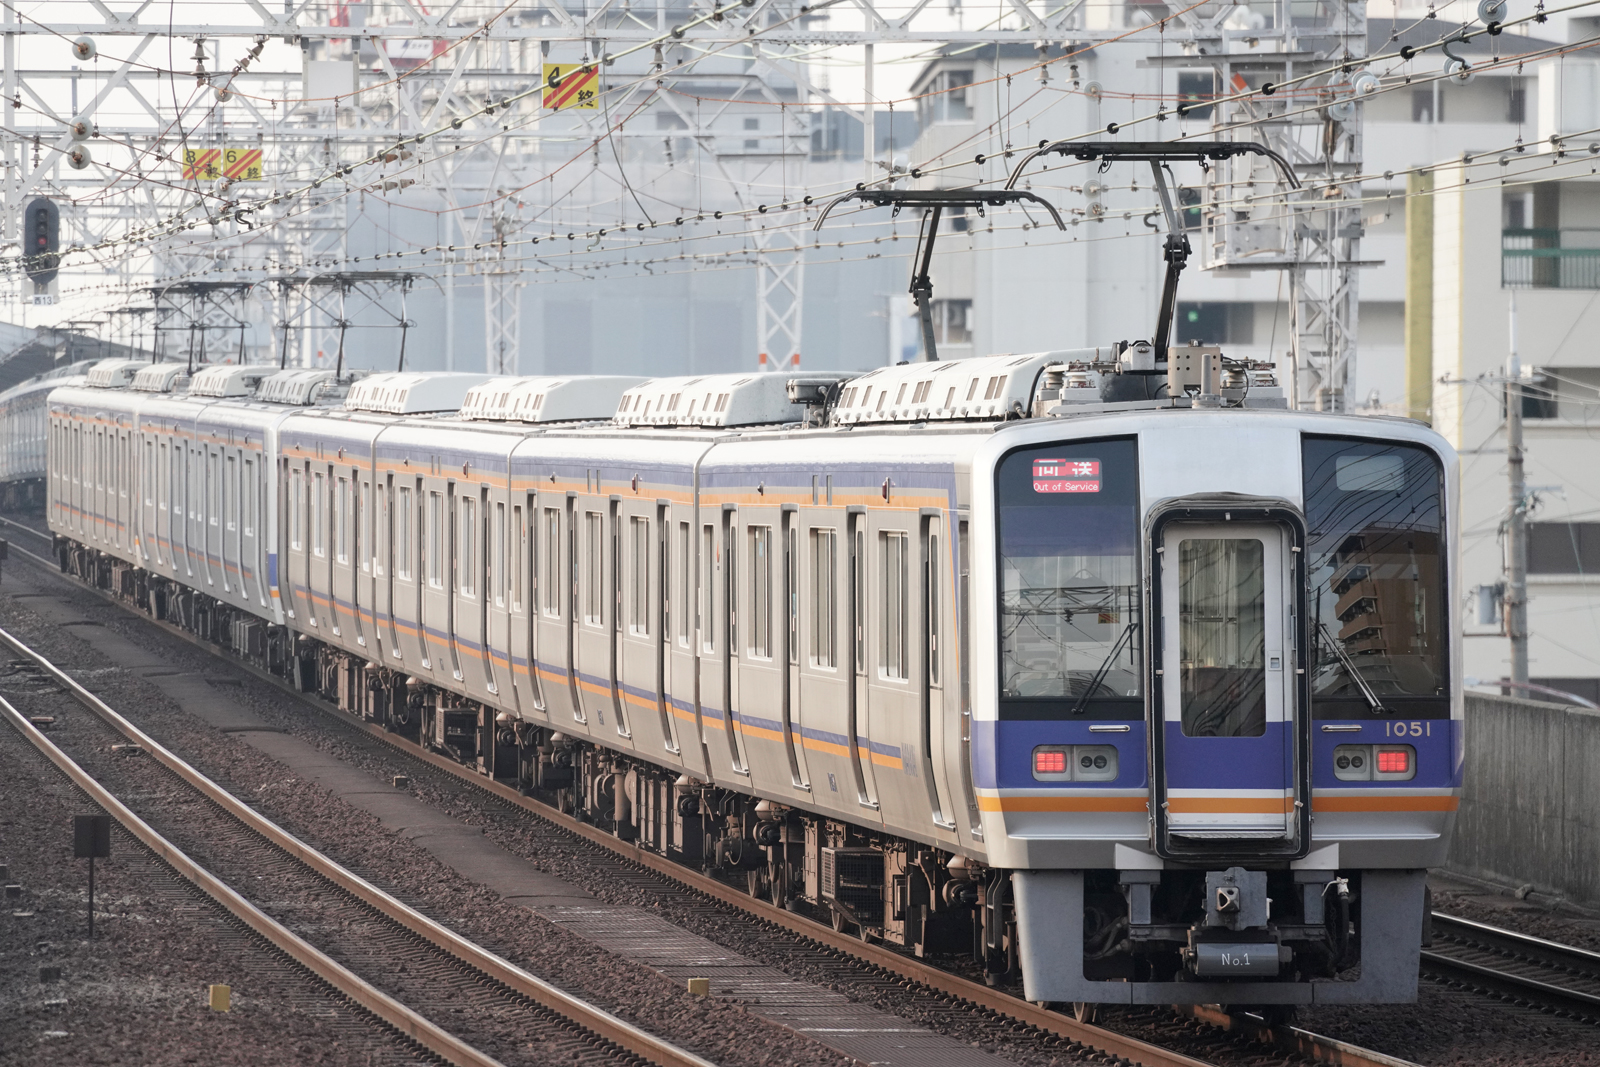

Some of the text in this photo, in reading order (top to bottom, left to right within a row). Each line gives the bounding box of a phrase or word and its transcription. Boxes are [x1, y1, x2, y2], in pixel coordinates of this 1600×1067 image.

[578, 90, 594, 107] 終
[186, 151, 196, 163] 8
[227, 151, 237, 163] 6
[247, 167, 259, 178] 終
[1039, 460, 1093, 477] 回送
[1034, 482, 1098, 491] Out of Service
[1386, 722, 1430, 737] 1051
[1221, 953, 1251, 966] No.1
